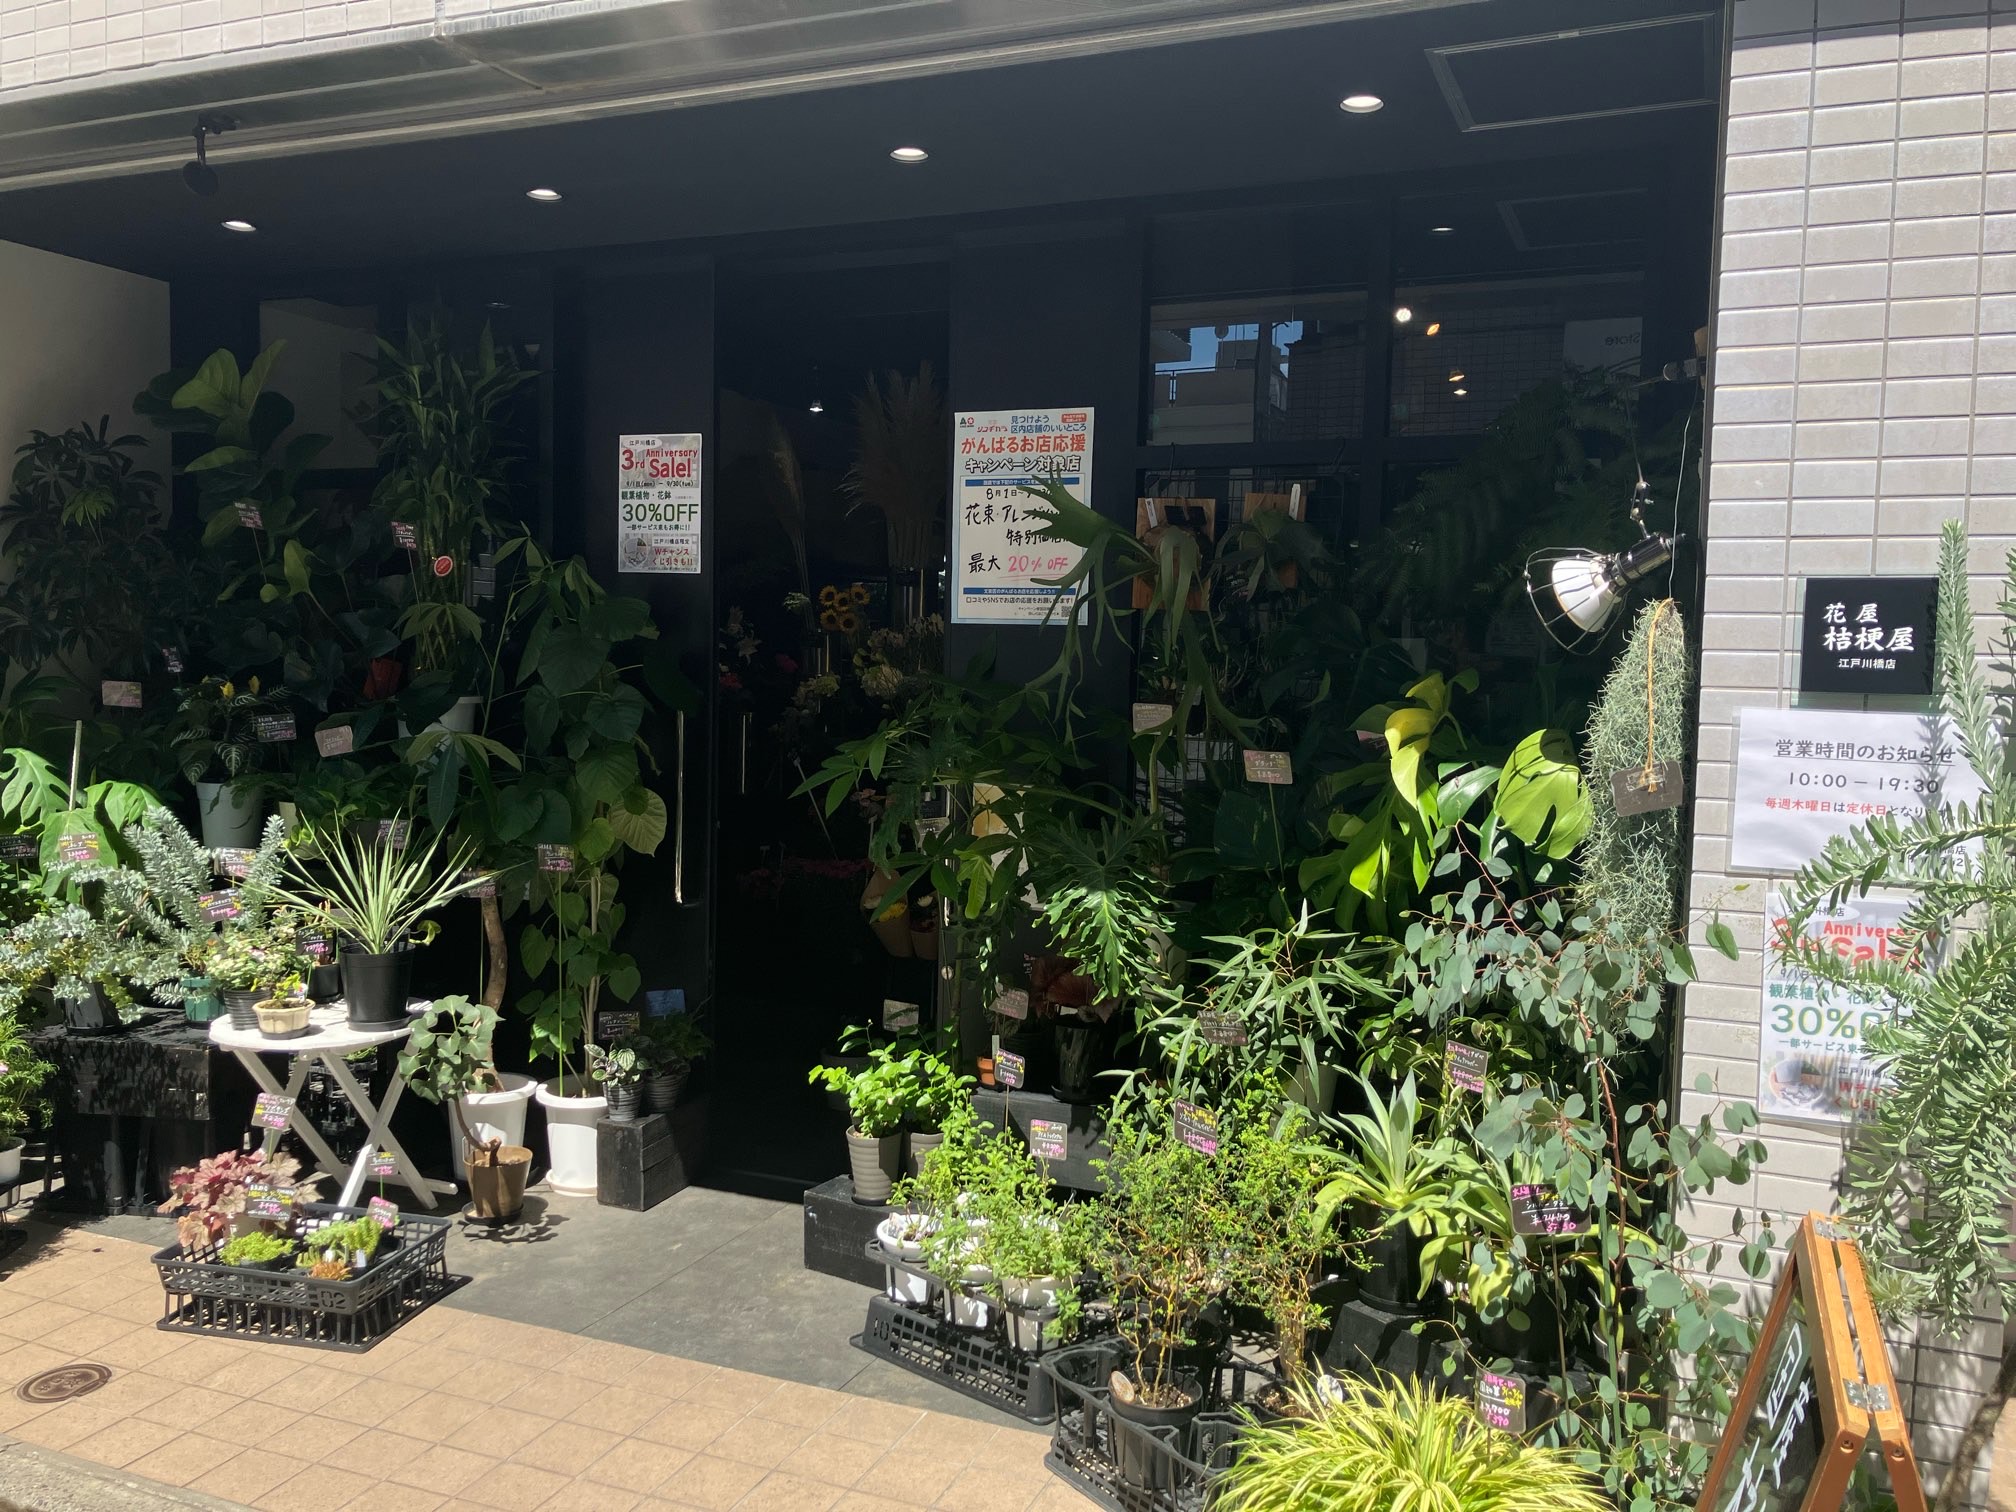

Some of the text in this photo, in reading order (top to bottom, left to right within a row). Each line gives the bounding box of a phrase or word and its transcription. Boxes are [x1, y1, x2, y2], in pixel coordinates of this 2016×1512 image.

[1010, 424, 1087, 434] 区内店舗のいいところ
[1011, 415, 1050, 425] 見つけよう
[646, 448, 698, 458] Anniversary
[961, 433, 1087, 455] がんばるお店応援
[965, 455, 1081, 474] キャンペーン対象店
[622, 503, 700, 523] 30%OFF
[968, 552, 1069, 574] 最大 20% OFF
[1822, 626, 1915, 652] 桔梗屋
[1838, 658, 1897, 670] 江戸川橋店
[1775, 738, 1956, 764] 営業時間のお知らせ
[1788, 772, 1848, 789] 10:00
[1879, 777, 1940, 794] 19:30
